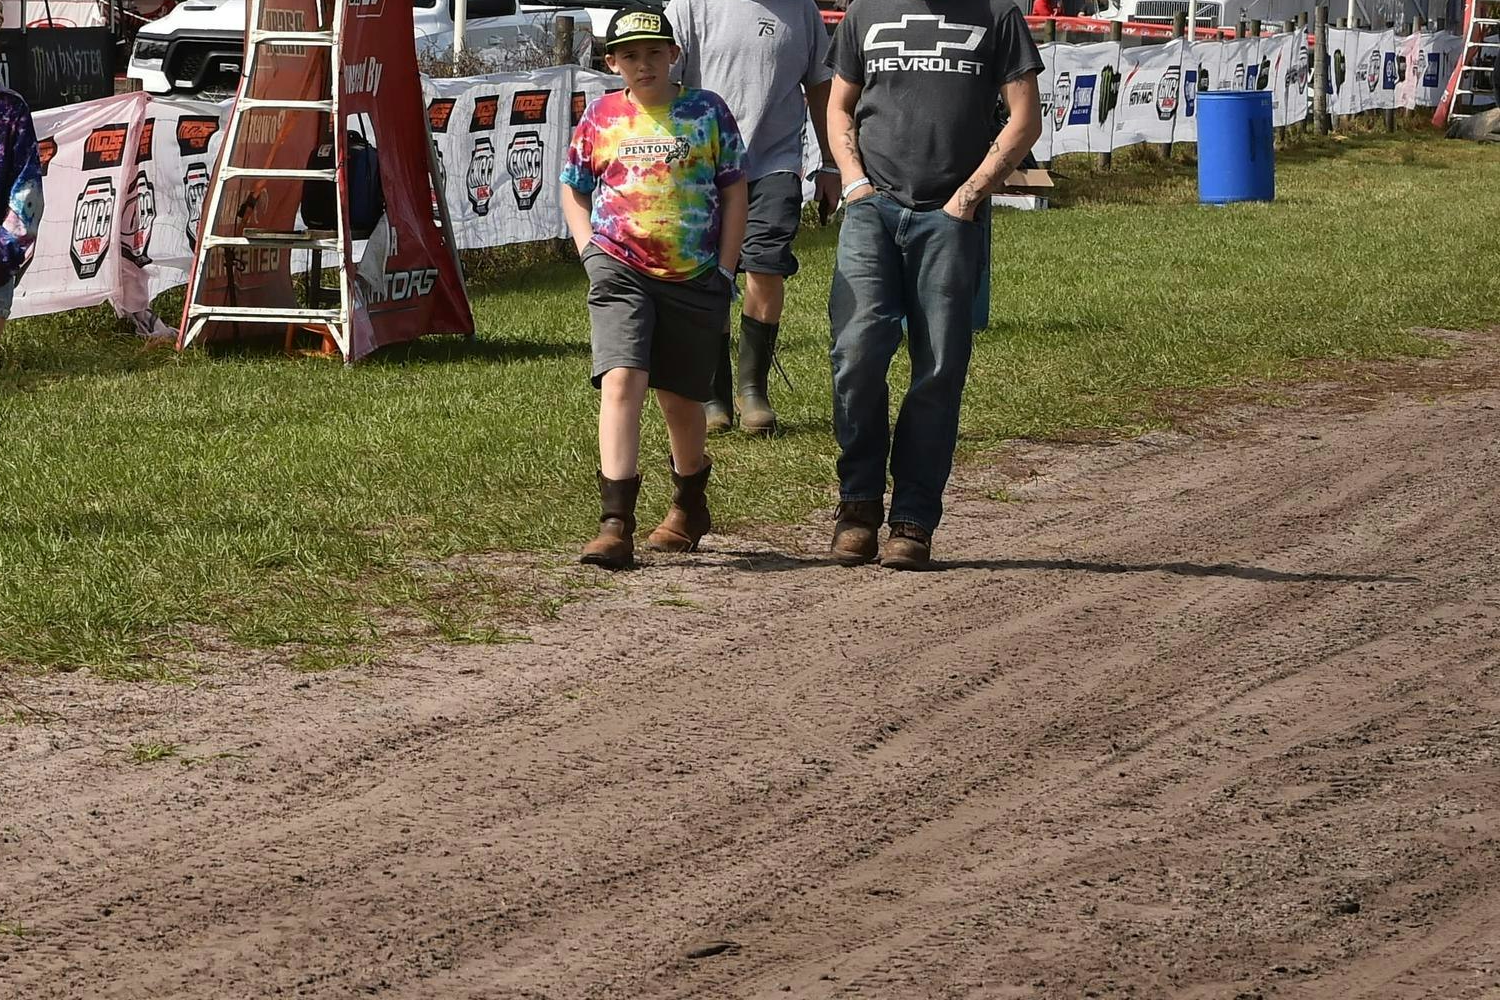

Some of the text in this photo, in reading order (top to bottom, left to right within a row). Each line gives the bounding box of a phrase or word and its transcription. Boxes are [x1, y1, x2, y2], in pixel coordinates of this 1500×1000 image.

[758, 21, 775, 37] 75
[867, 57, 984, 76] CHEVROLET
[366, 56, 383, 97] By
[625, 144, 670, 155] PENTON
[75, 198, 113, 241] GNCC
